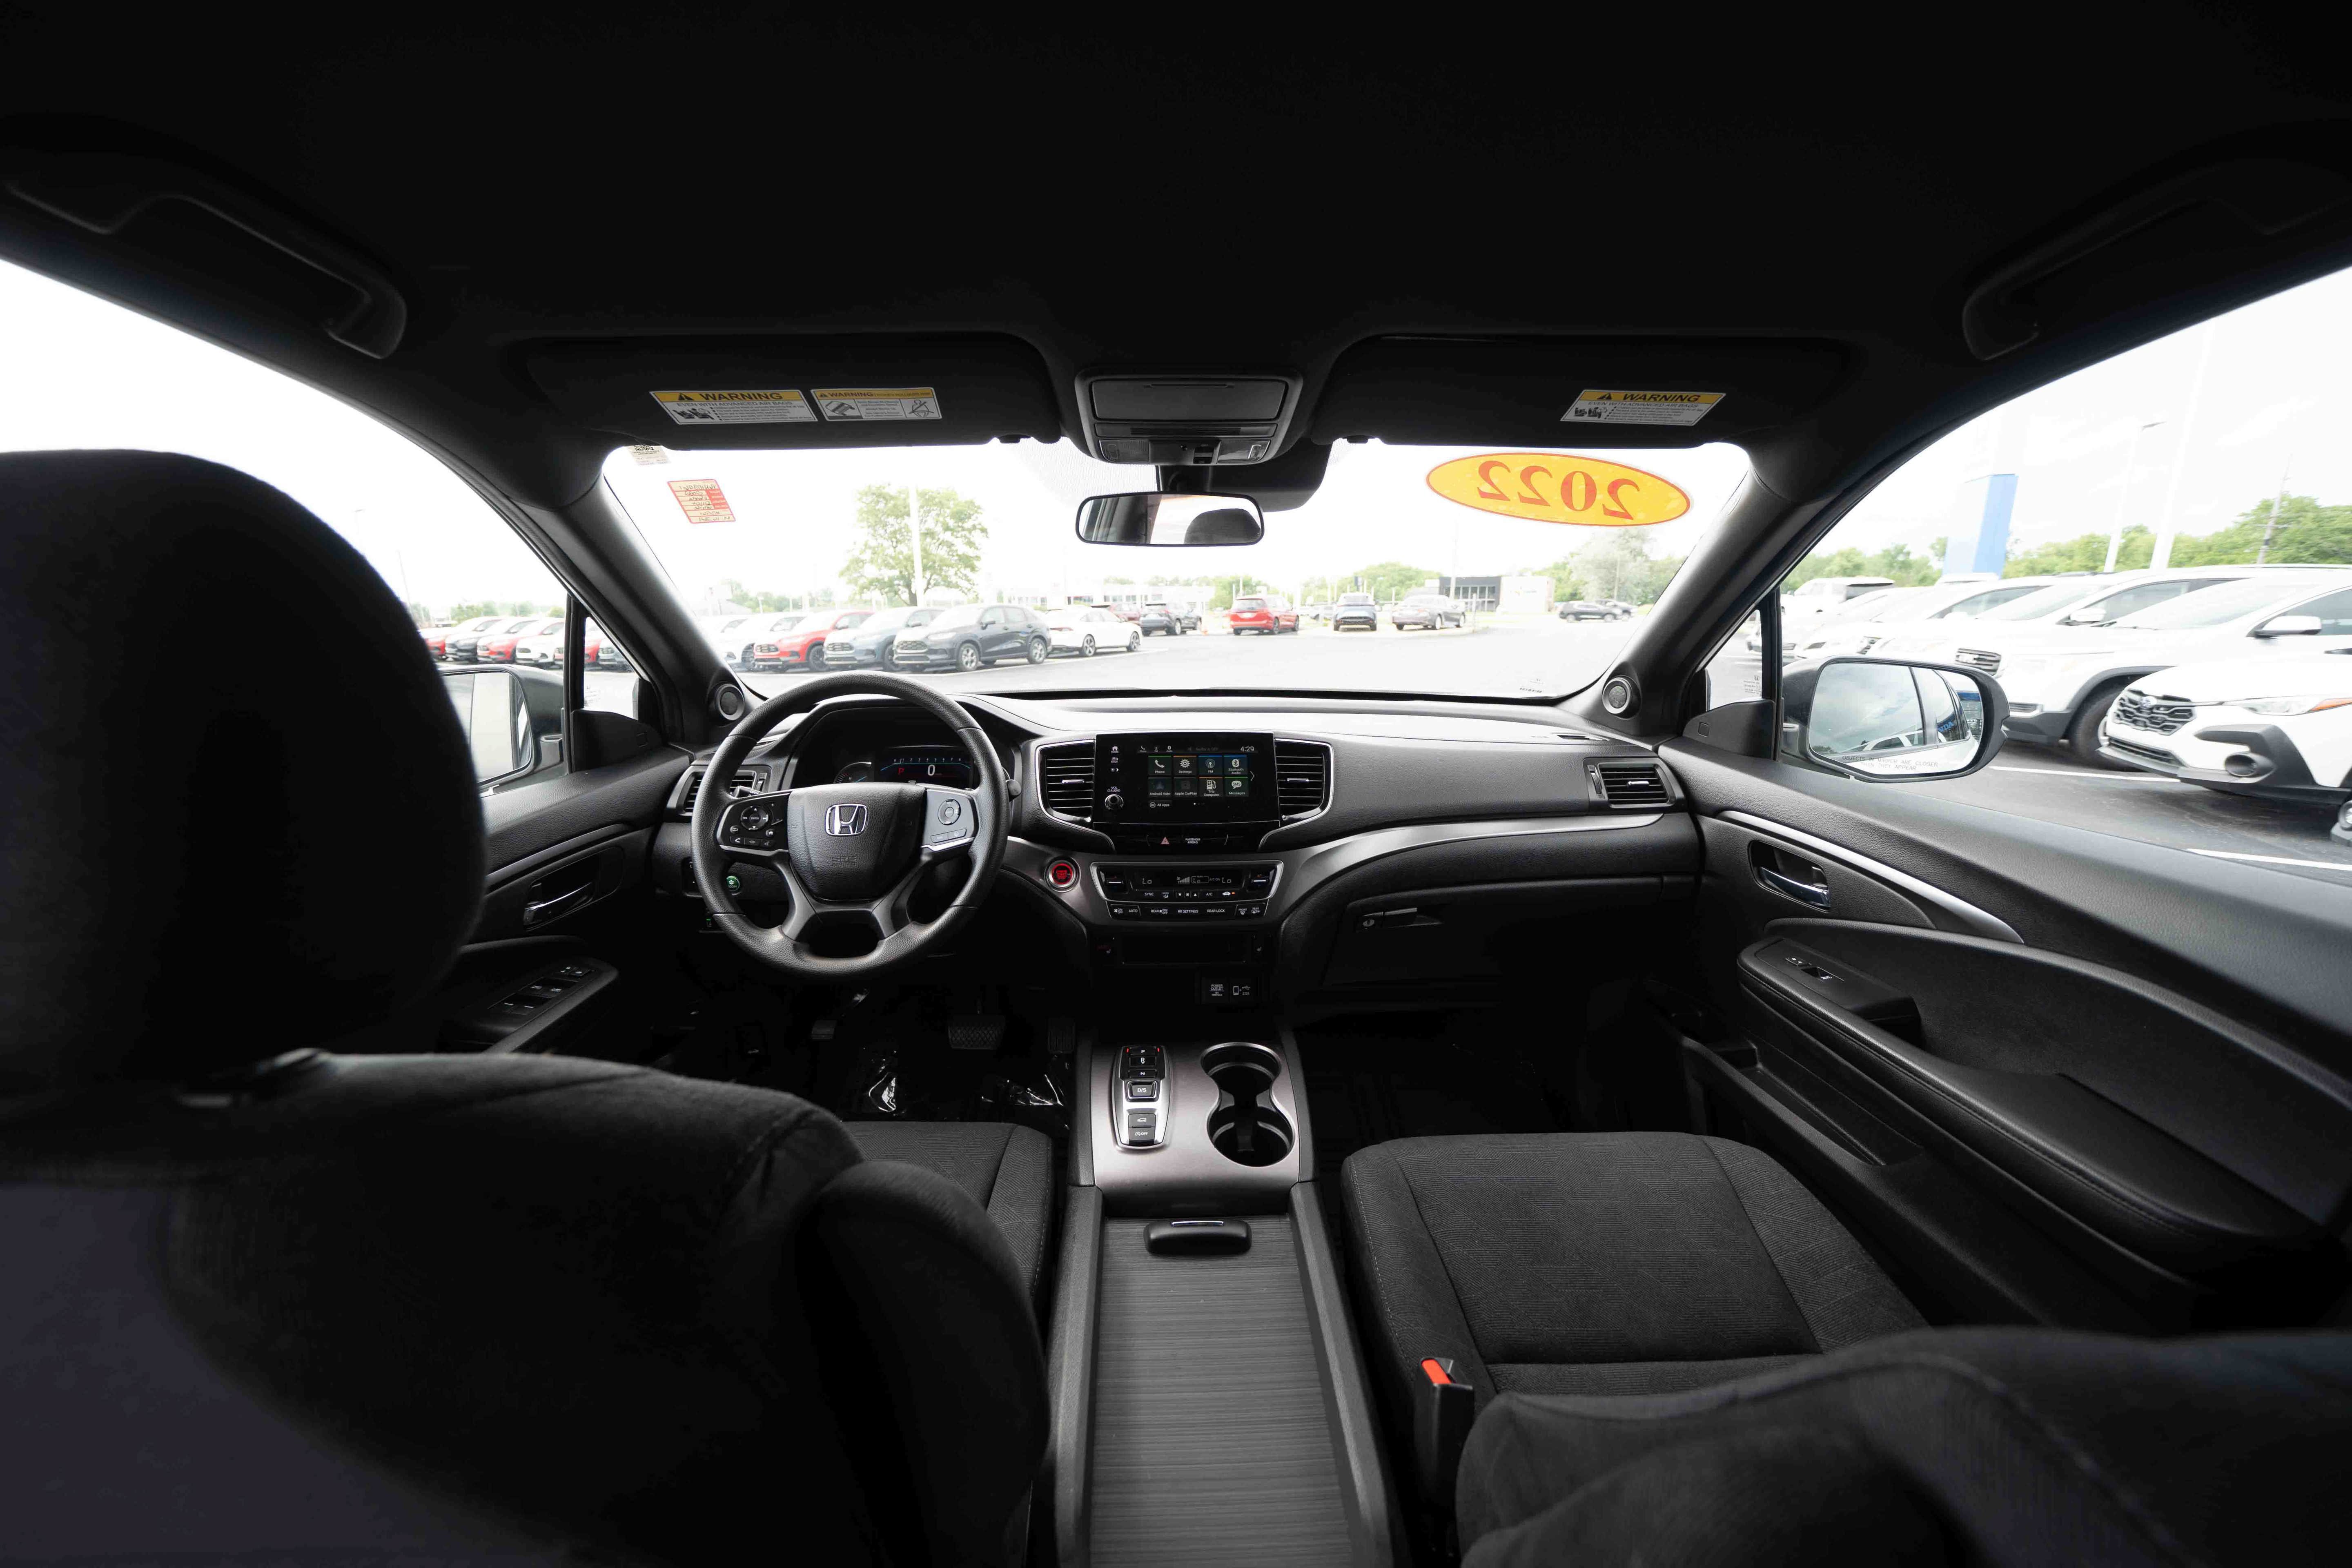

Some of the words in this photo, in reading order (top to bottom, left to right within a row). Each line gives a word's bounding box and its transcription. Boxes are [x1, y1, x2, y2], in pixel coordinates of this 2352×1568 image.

[699, 392, 784, 401] WARNING
[1623, 394, 1702, 403] WARNING
[928, 764, 935, 776] 0
